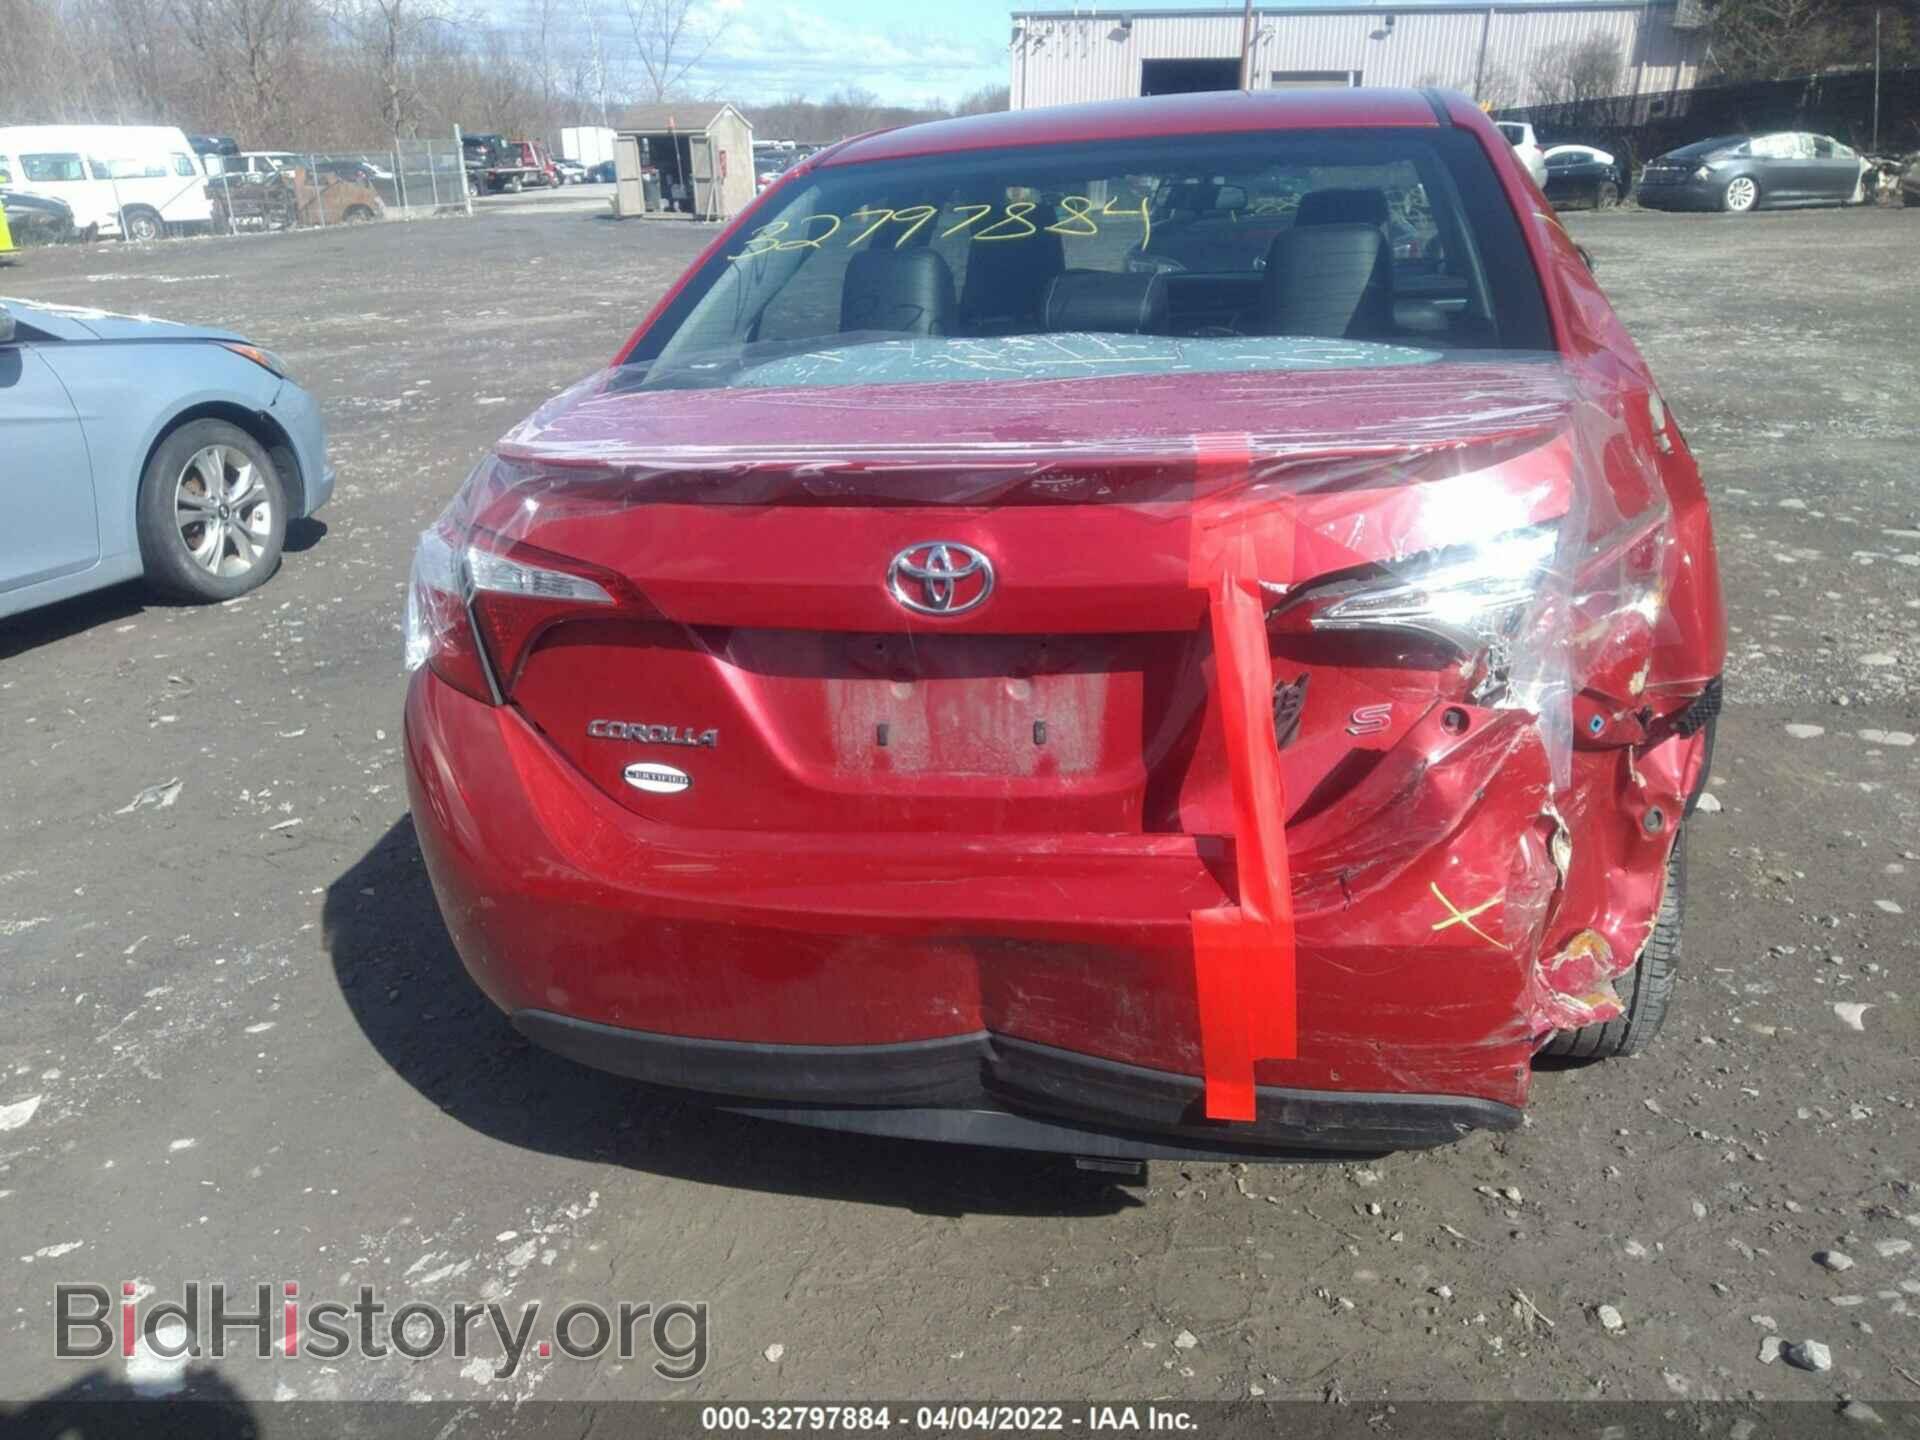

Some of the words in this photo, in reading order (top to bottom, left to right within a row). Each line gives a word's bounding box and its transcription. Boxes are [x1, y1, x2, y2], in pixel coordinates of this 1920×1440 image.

[727, 195, 1152, 261] 32797884
[587, 719, 719, 747] COROLLA
[1344, 702, 1393, 736] S
[624, 769, 690, 785] CERTIFIED
